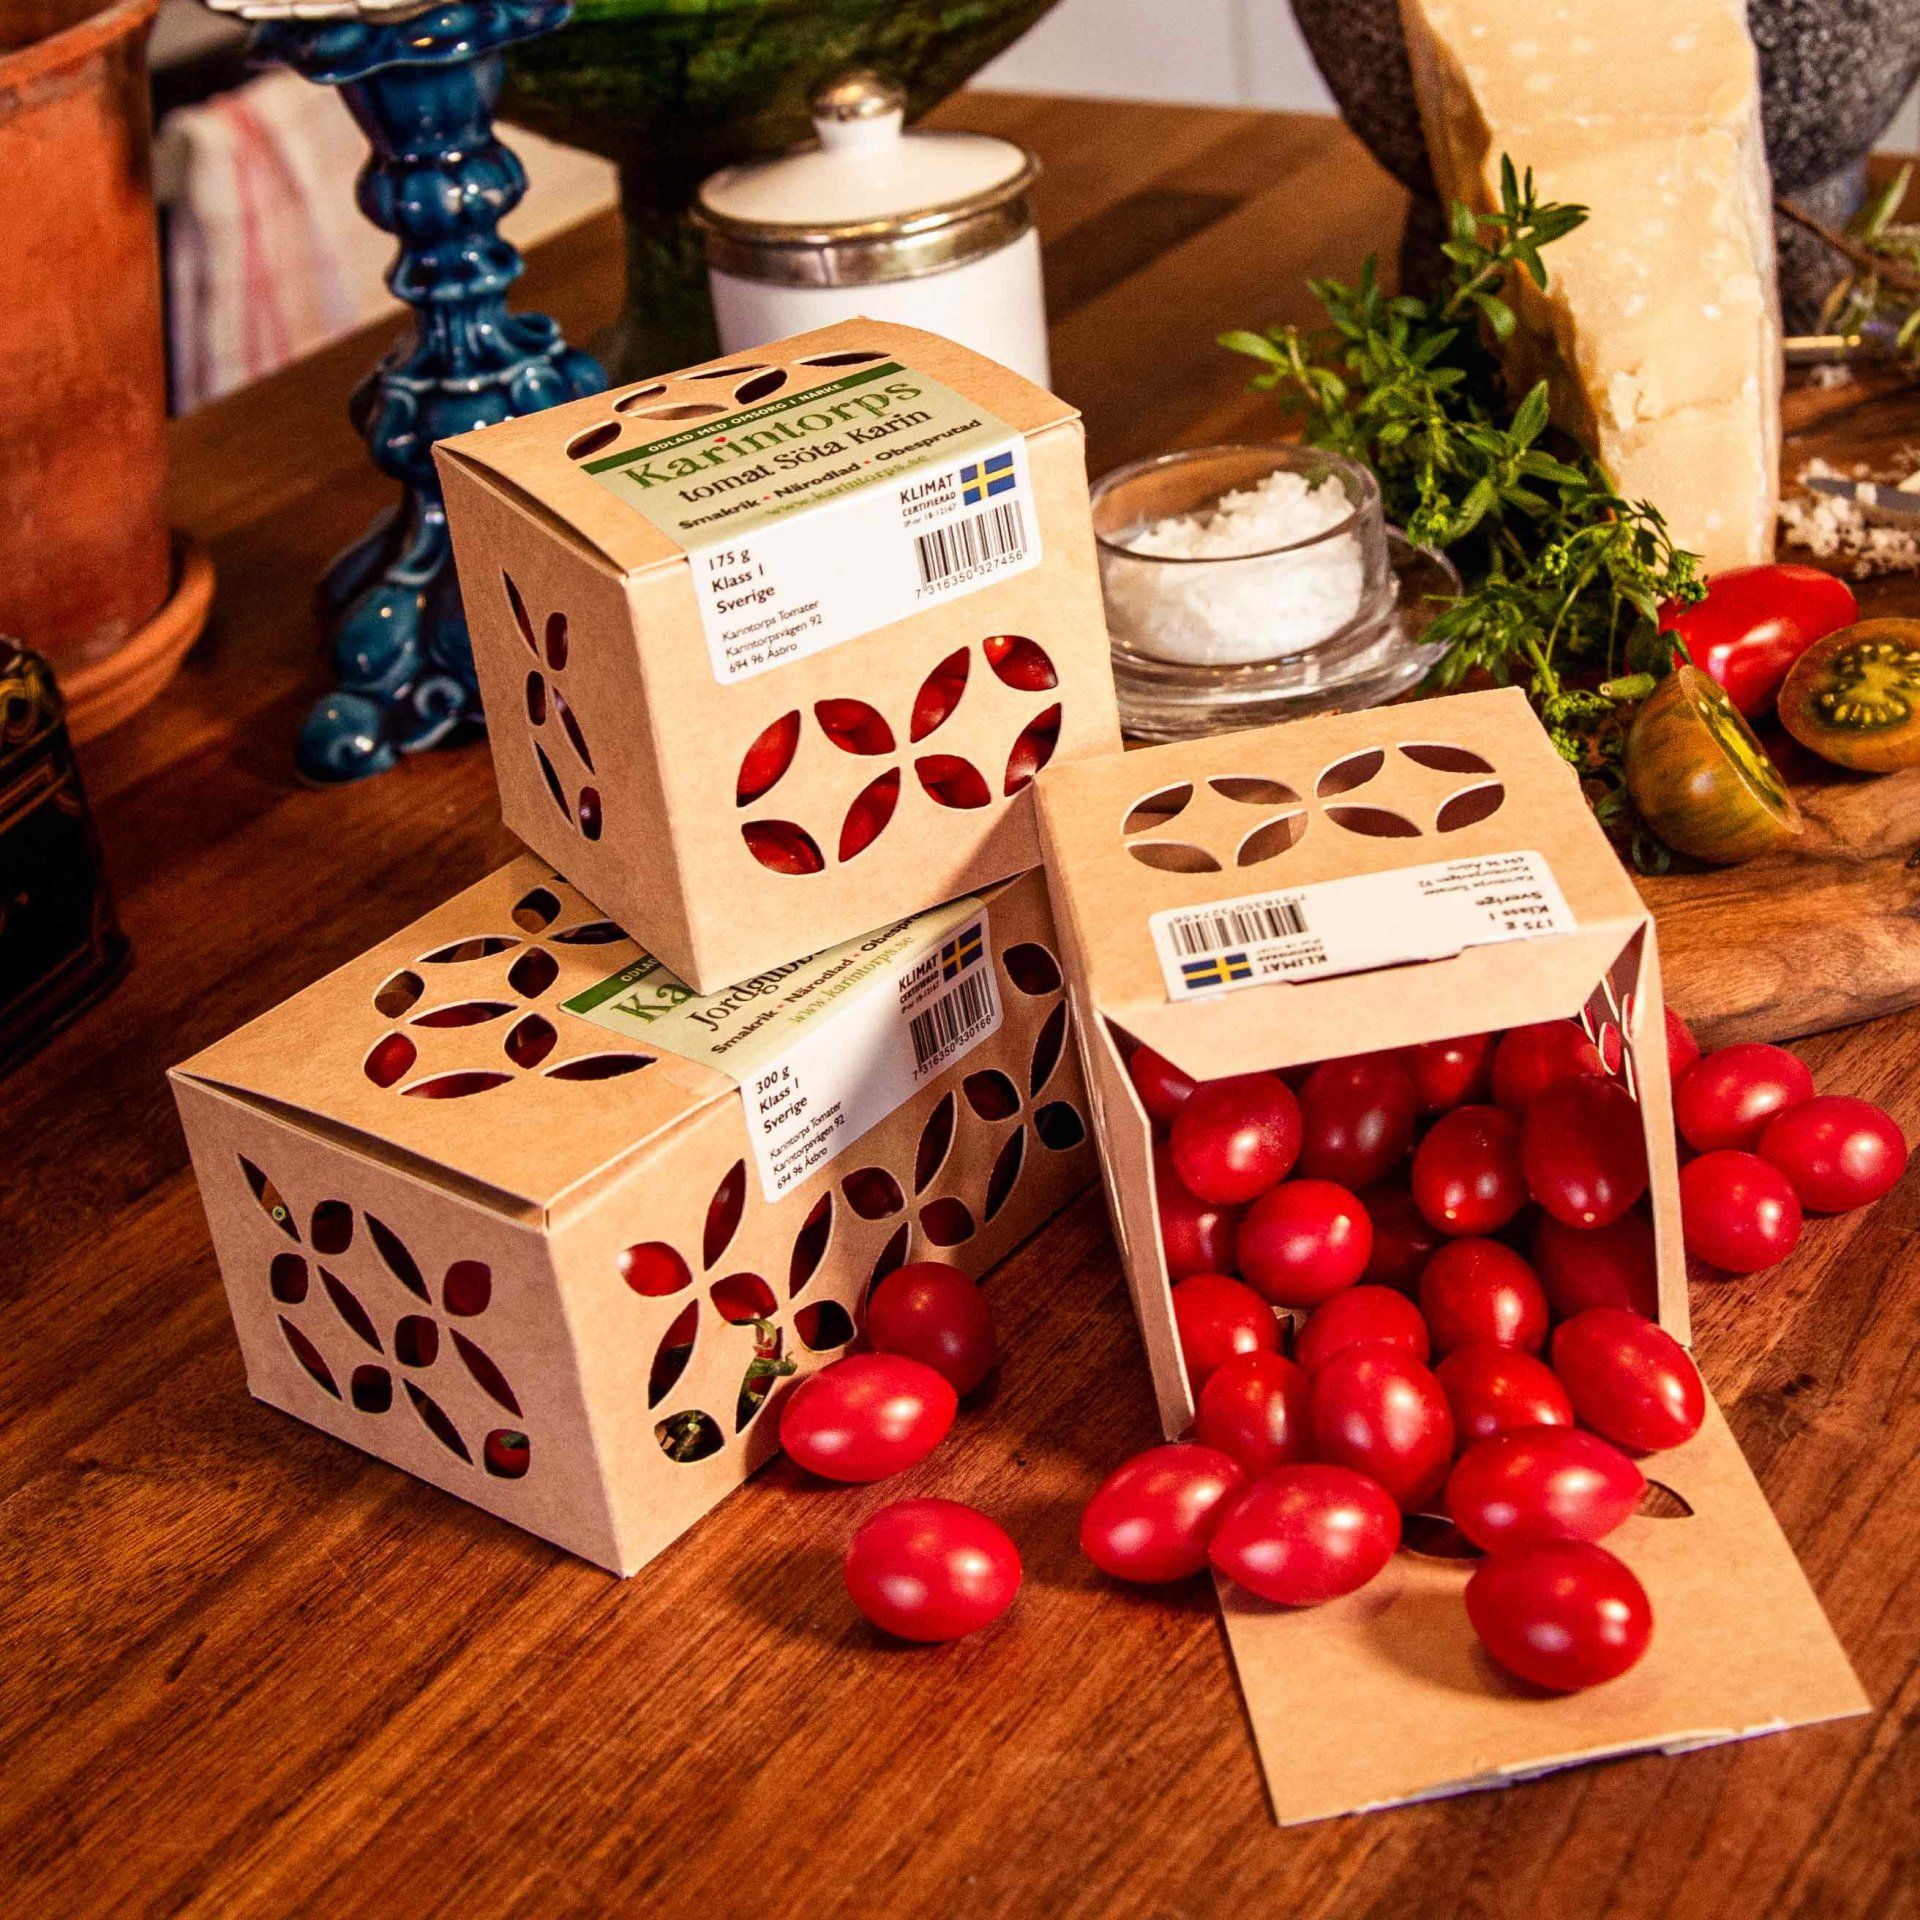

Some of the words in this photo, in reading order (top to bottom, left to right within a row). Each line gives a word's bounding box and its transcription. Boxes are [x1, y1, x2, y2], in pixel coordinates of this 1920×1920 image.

[619, 383, 922, 489] Karintorps
[648, 434, 693, 452] ODLAD
[697, 422, 728, 435] MED
[731, 400, 787, 425] OMSORG
[790, 397, 797, 405] I
[678, 464, 776, 502] tomat
[773, 440, 848, 470] Söta
[843, 409, 934, 446] Karin
[678, 498, 760, 530] Smakrik
[773, 462, 862, 498] Närodlad
[875, 419, 983, 461] Obesprutad
[900, 474, 953, 505] KLIMAT
[902, 491, 956, 517] CERTIFIERAD
[708, 552, 736, 571] 175
[740, 548, 752, 564] g
[711, 570, 753, 593] Klass
[716, 585, 776, 614] Sverige
[722, 615, 777, 642] Karintorps
[779, 600, 820, 621] Tomater
[809, 614, 822, 626] 92
[729, 659, 749, 674] 694
[750, 654, 765, 667] 96
[789, 935, 914, 1025] www.karintorps.se
[899, 953, 939, 992] KLIMAT
[710, 1009, 780, 1054] Smakrik
[782, 959, 854, 1003] Närodlad
[756, 1071, 779, 1094] 300
[782, 1066, 790, 1080] g
[759, 1087, 791, 1114] Klass
[763, 1096, 808, 1134] Sverige
[770, 1126, 810, 1160] Karintorps
[810, 1101, 842, 1129] Tomater
[834, 1114, 846, 1128] 92
[776, 1173, 792, 1190] 694
[792, 1164, 803, 1175] 96
